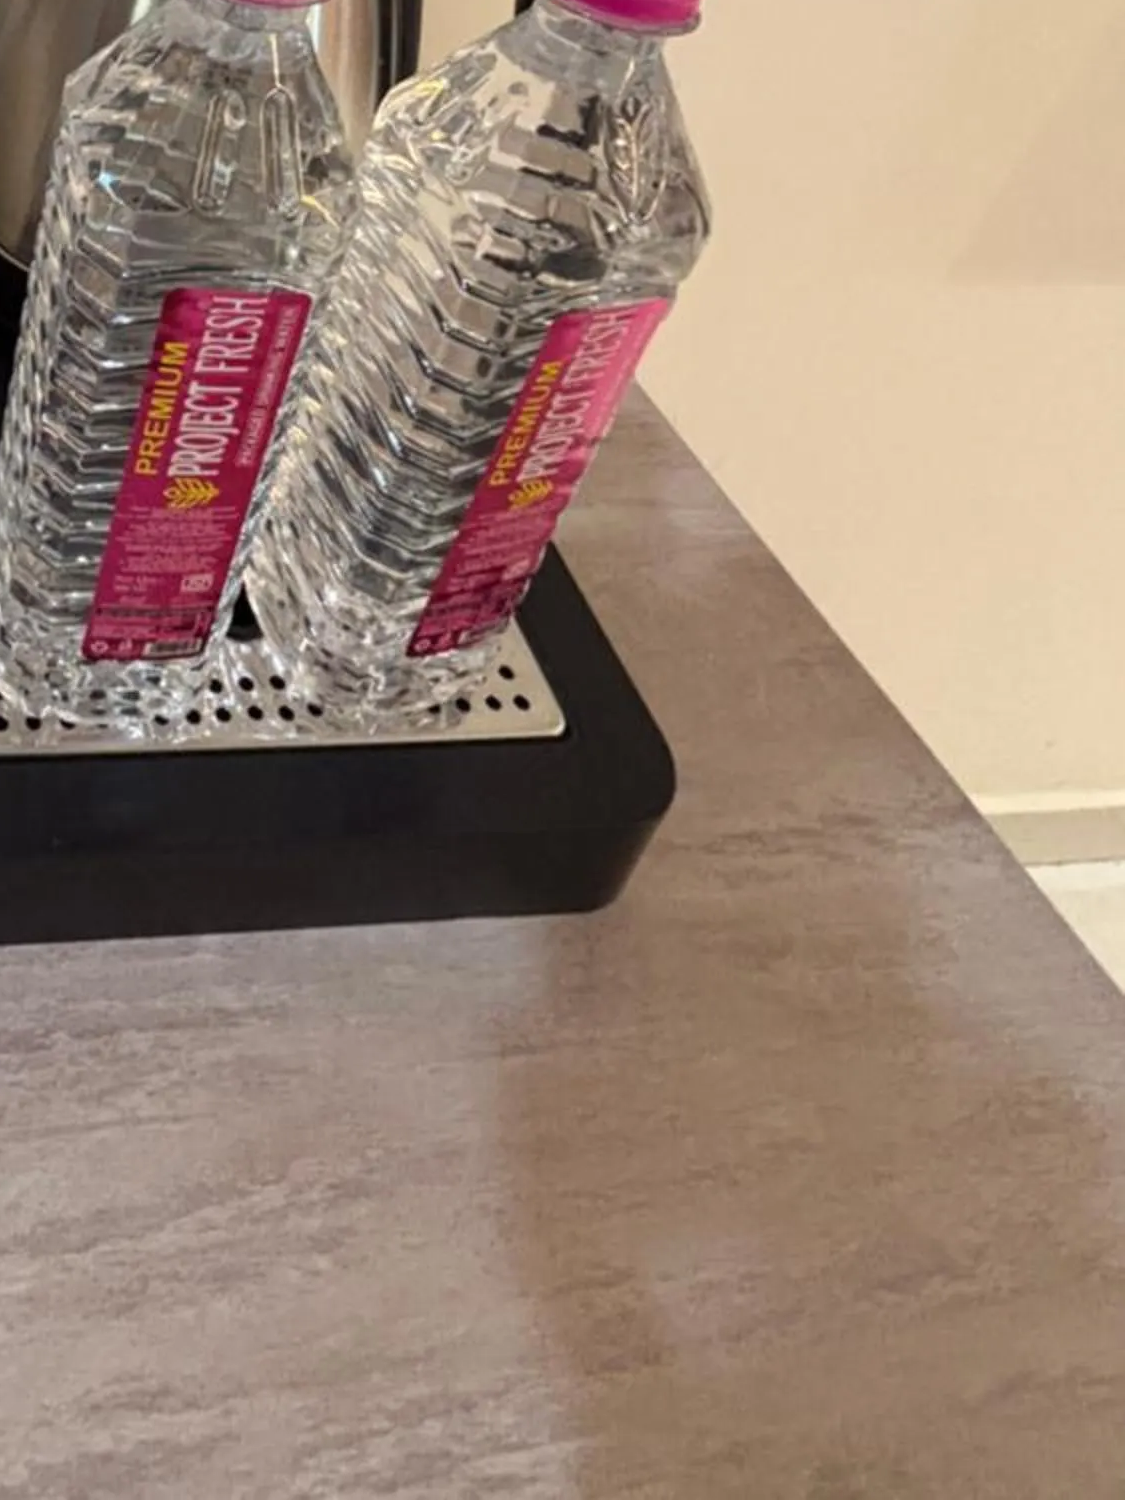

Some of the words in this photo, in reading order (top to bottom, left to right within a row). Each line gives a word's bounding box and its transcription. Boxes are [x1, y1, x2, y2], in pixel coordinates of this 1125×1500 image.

[194, 296, 269, 374] FRESH
[135, 341, 190, 476] PREMIUM
[167, 382, 242, 478] PROJECT
[489, 361, 564, 487] PREMIUM
[517, 389, 594, 483] PROJECT
